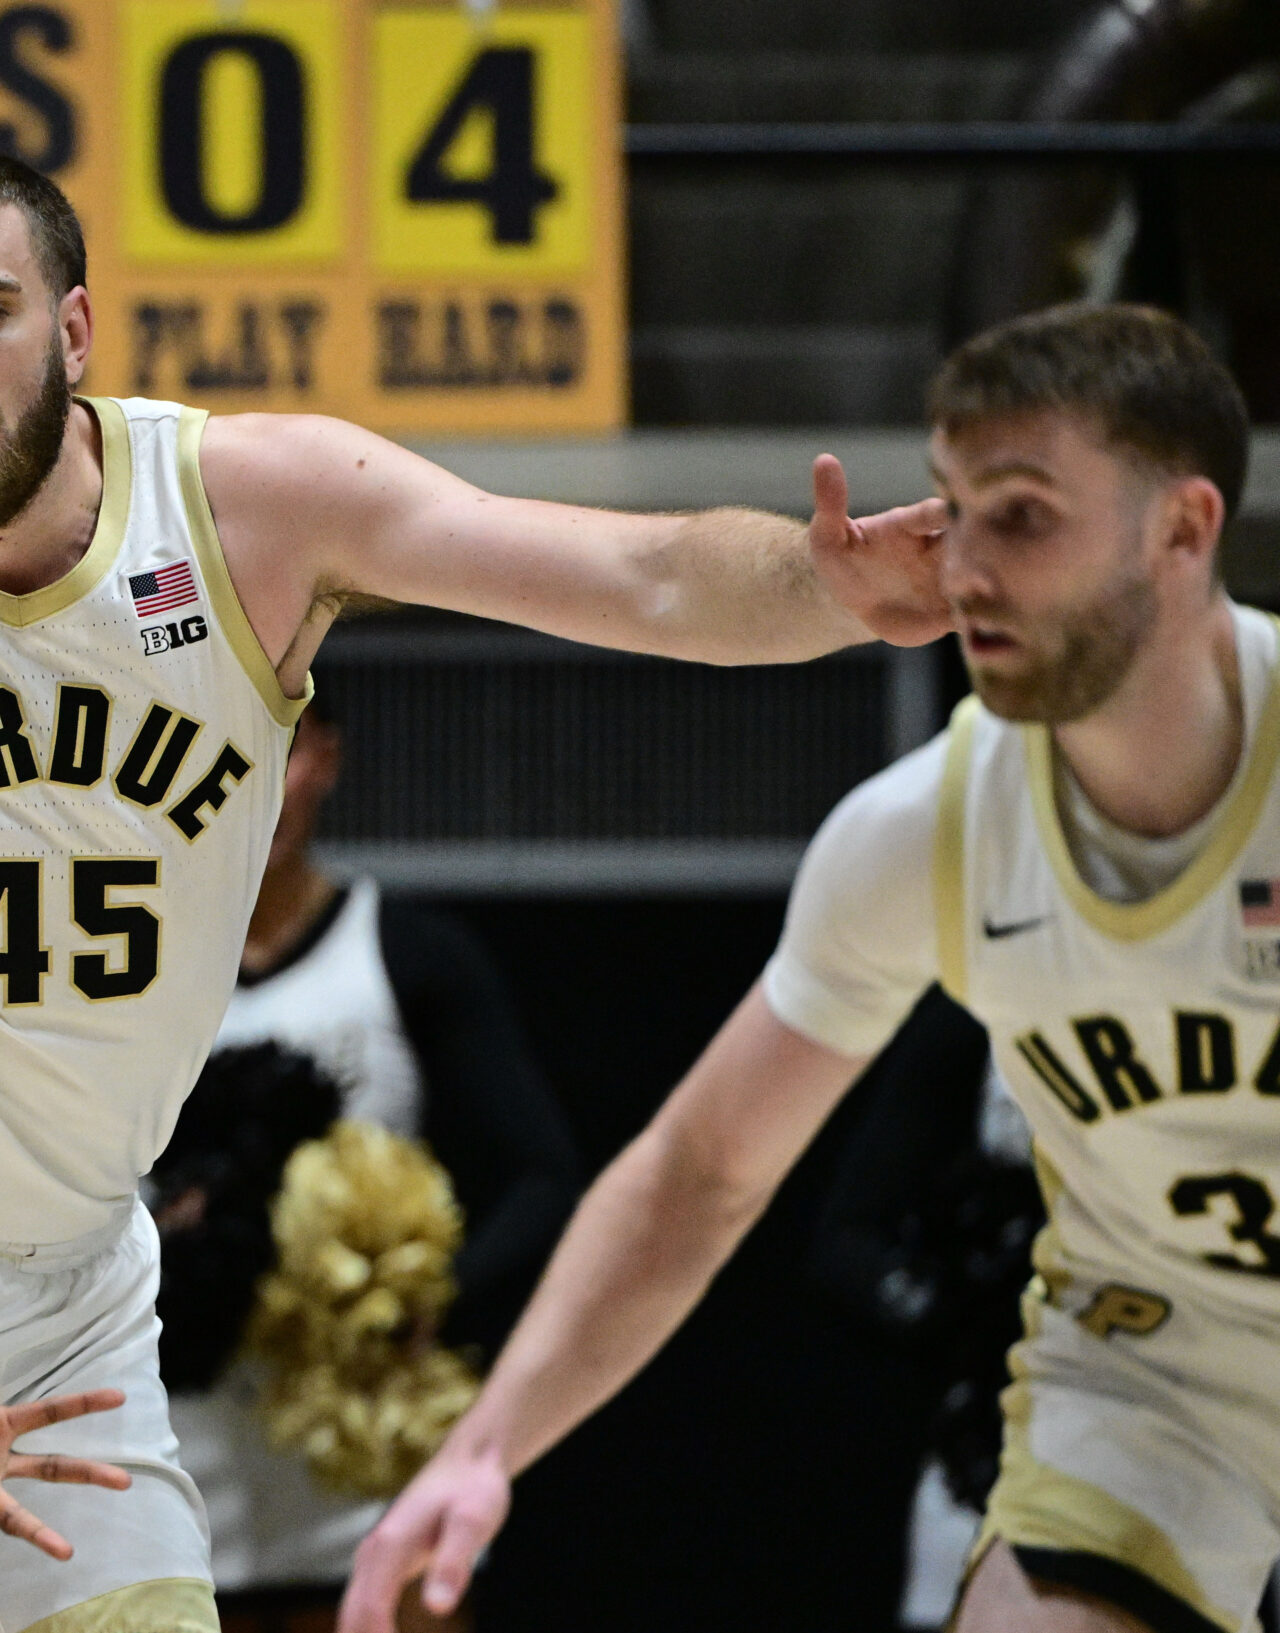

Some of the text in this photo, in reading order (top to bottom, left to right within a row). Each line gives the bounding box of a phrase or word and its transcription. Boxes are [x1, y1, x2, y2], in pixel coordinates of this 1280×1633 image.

[156, 28, 560, 246] 0 4
[135, 298, 584, 390] PLAY HARD
